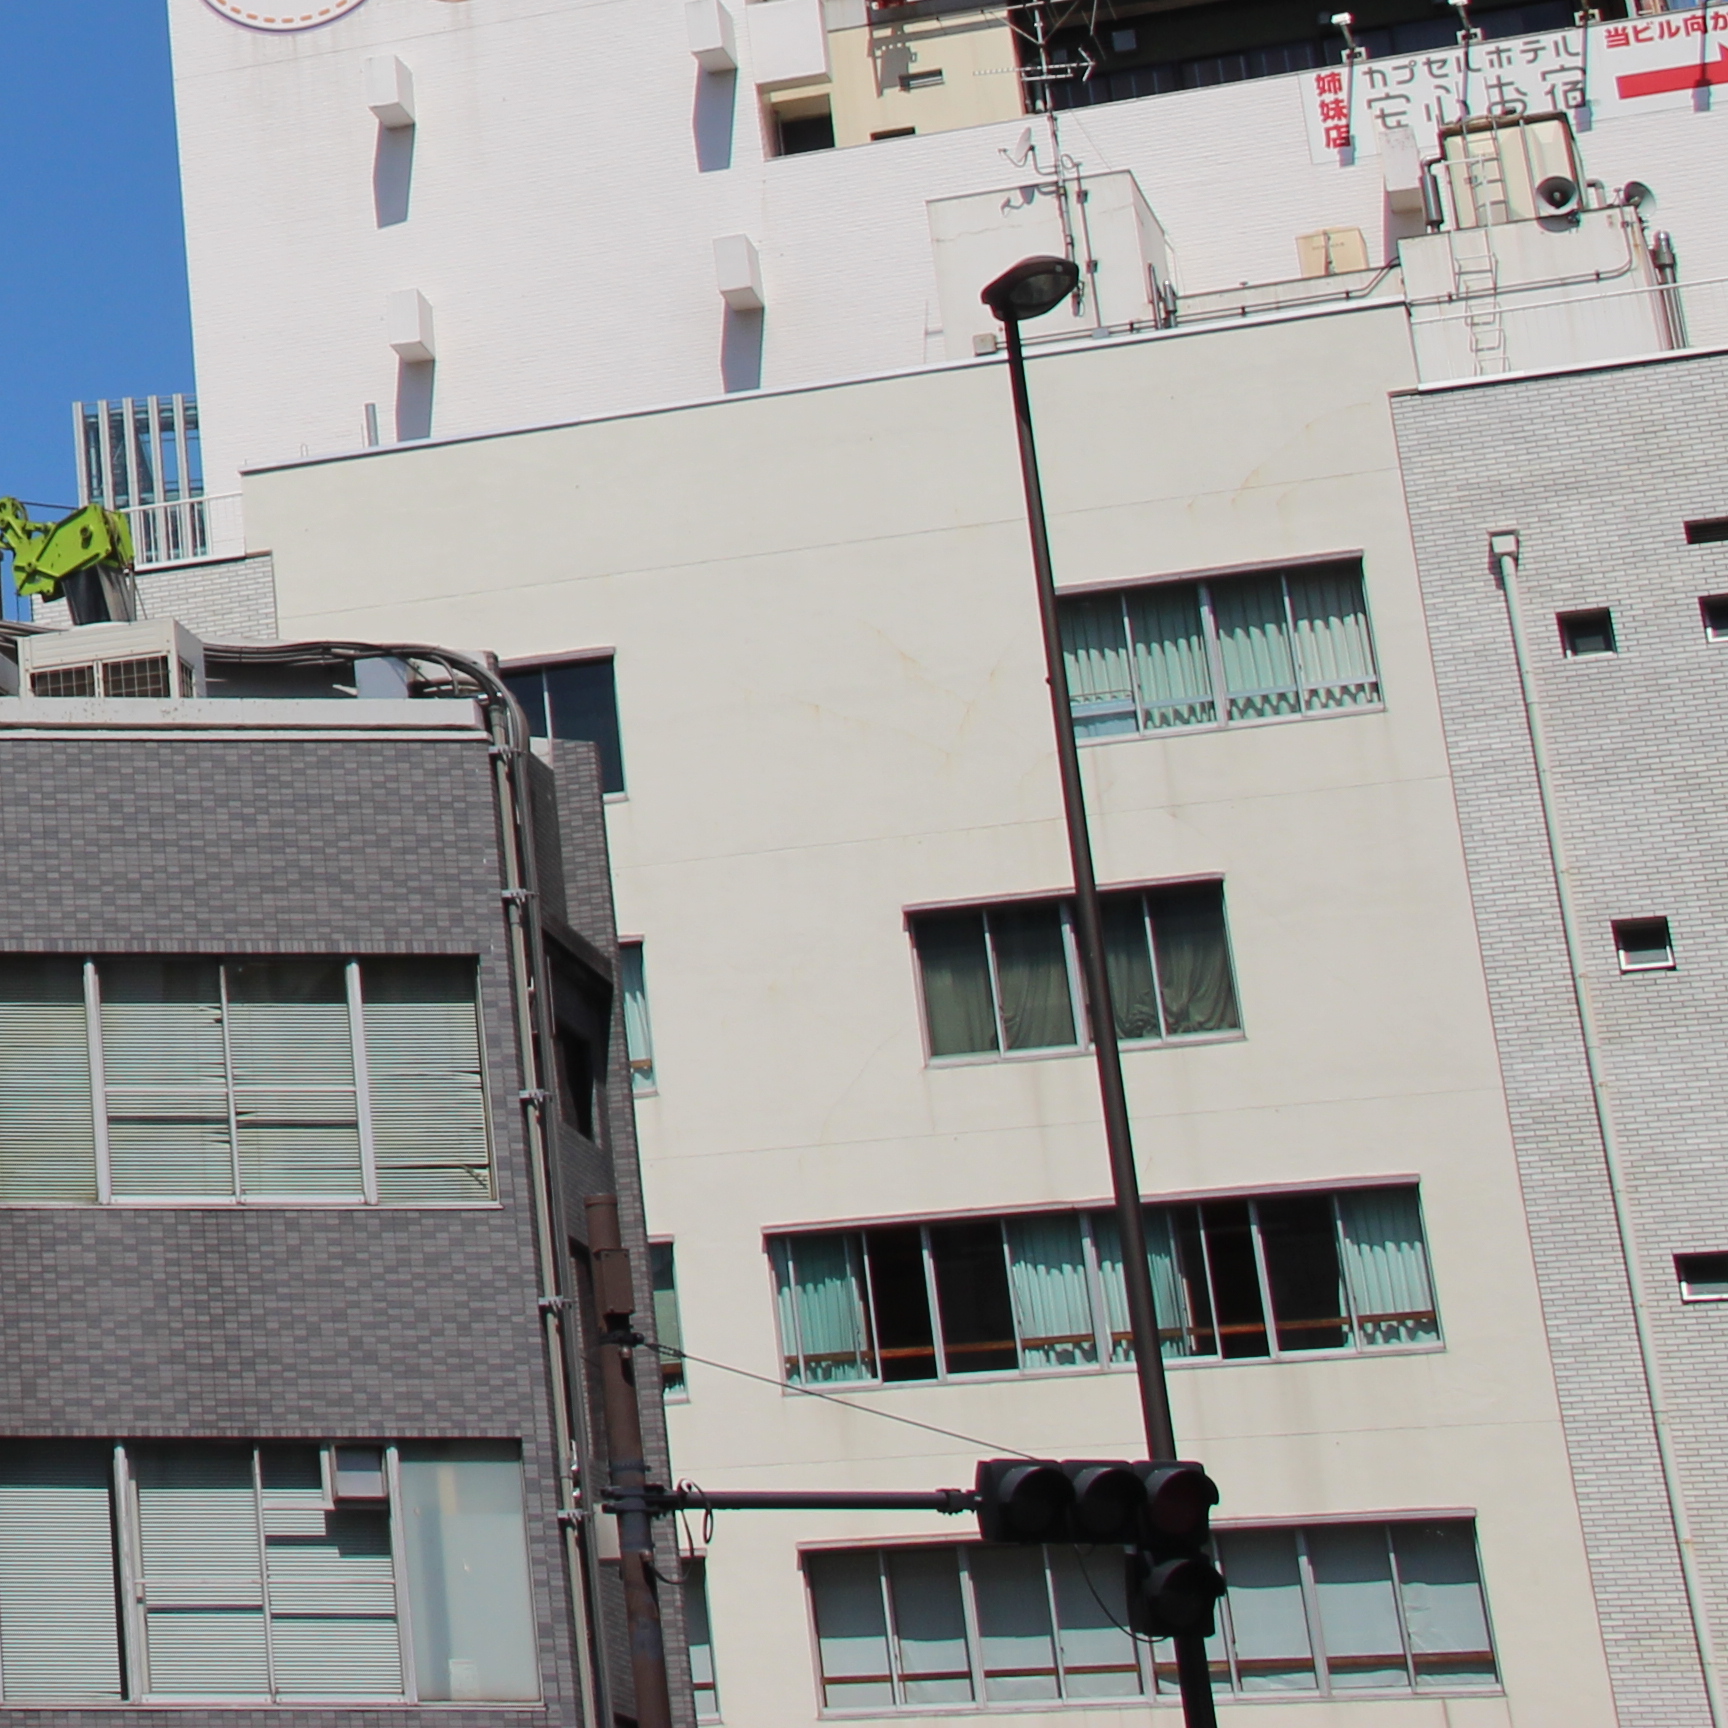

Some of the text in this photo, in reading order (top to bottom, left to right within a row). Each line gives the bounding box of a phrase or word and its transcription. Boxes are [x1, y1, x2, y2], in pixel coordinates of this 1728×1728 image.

[1362, 35, 1581, 89] カプセルホテル
[1314, 72, 1351, 149] 姉妹店
